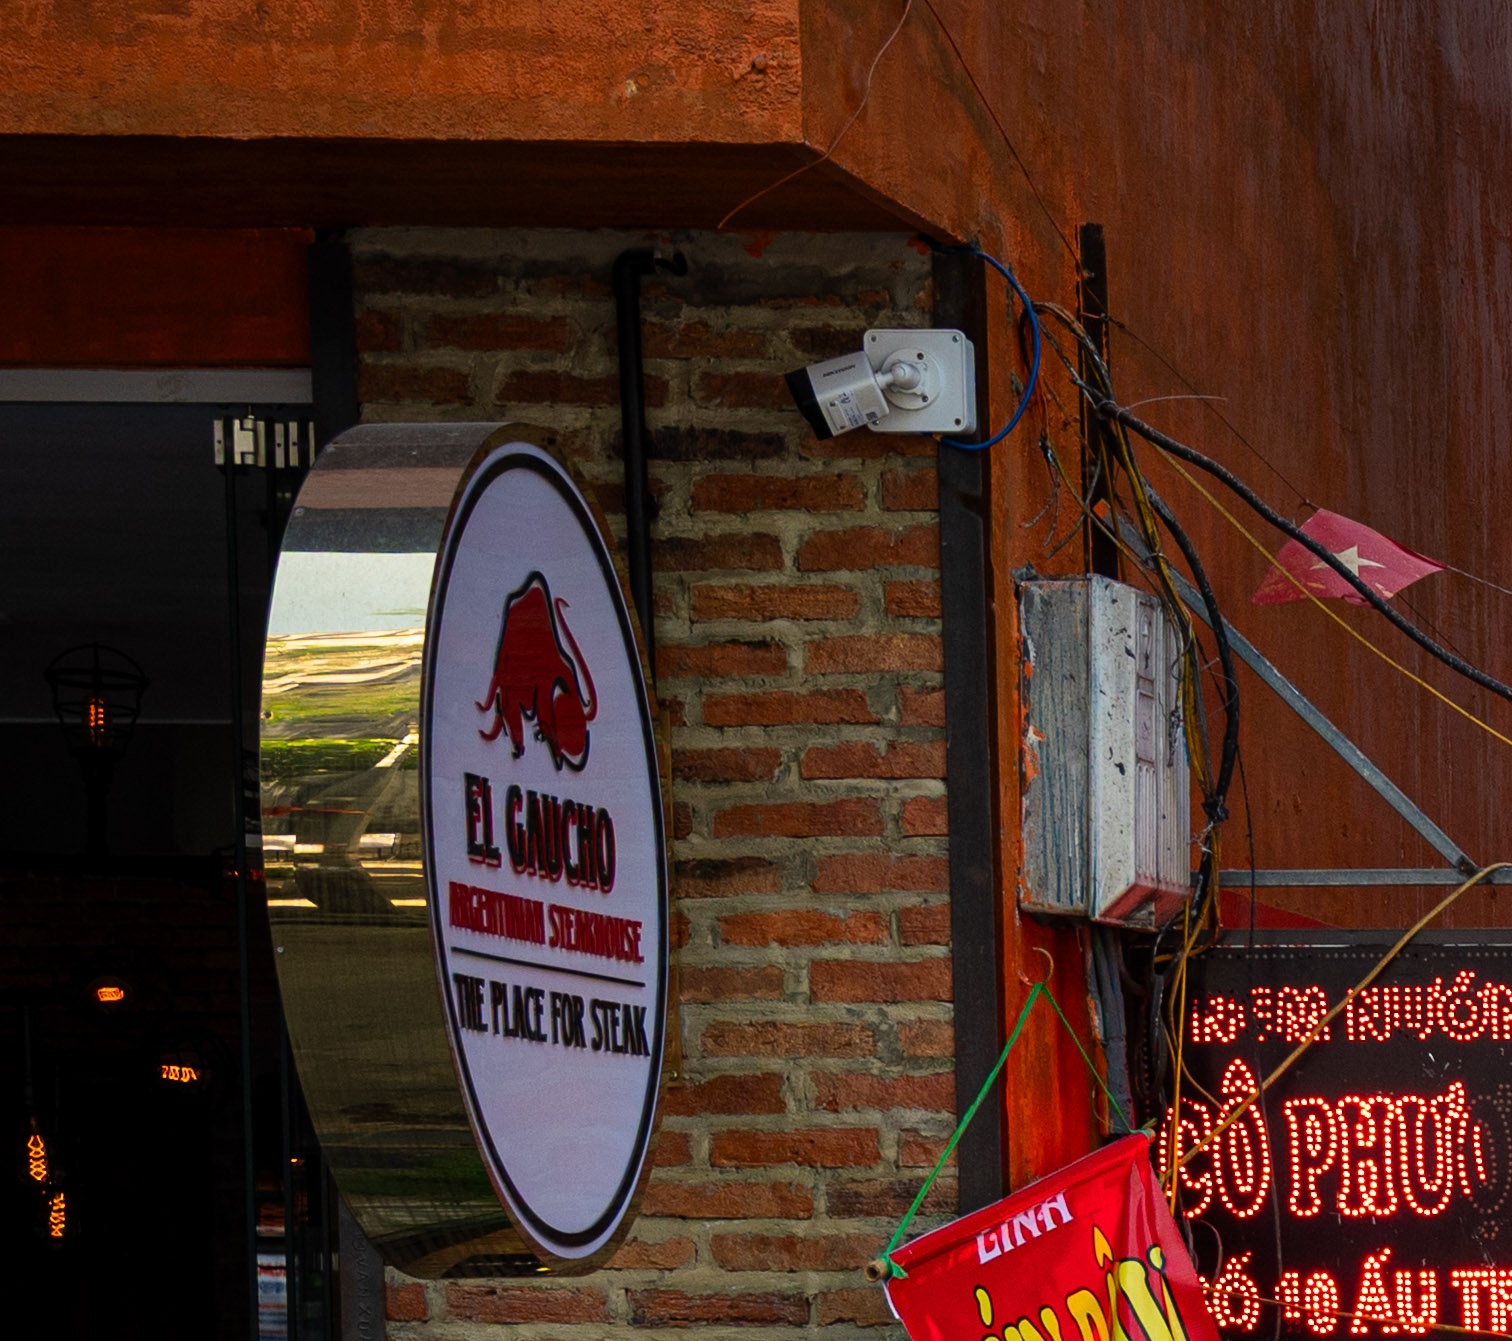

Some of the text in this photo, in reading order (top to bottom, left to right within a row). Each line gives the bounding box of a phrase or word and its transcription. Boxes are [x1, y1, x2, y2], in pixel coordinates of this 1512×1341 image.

[464, 772, 616, 894] EL GAUCHO
[548, 903, 644, 963] STEAKHOUSE
[453, 972, 650, 1056] THE PLACE FOR STEAK
[976, 1191, 1074, 1265] LINH
[1275, 1271, 1339, 1333] 10
[1350, 1248, 1438, 1334] ẤU
